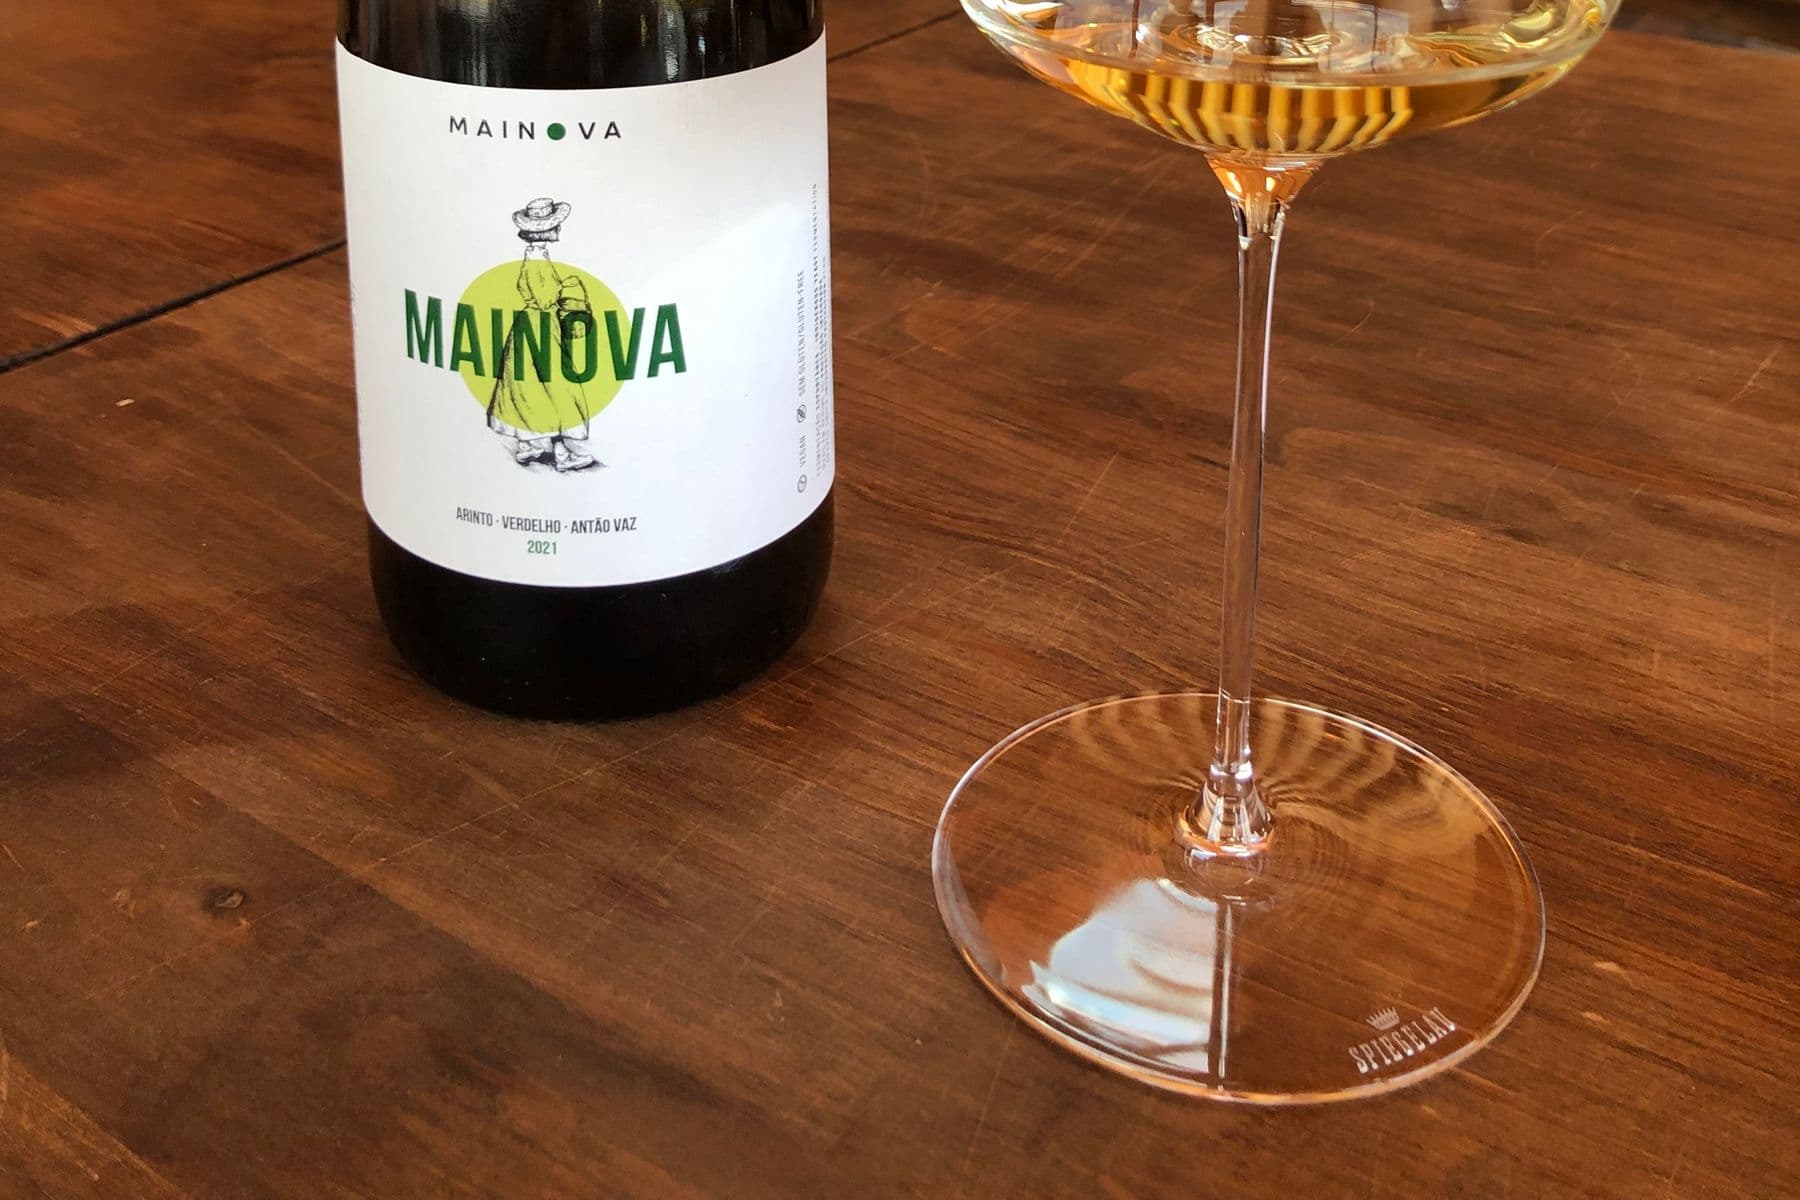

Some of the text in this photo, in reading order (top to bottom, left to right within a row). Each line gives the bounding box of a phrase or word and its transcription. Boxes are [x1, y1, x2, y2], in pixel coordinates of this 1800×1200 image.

[404, 287, 688, 385] MAINOVA
[456, 506, 638, 535] ARINTO VERDELHO ANTÃO VAZ
[527, 539, 558, 556] 2021
[1348, 1006, 1456, 1074] SPIEGELAU
